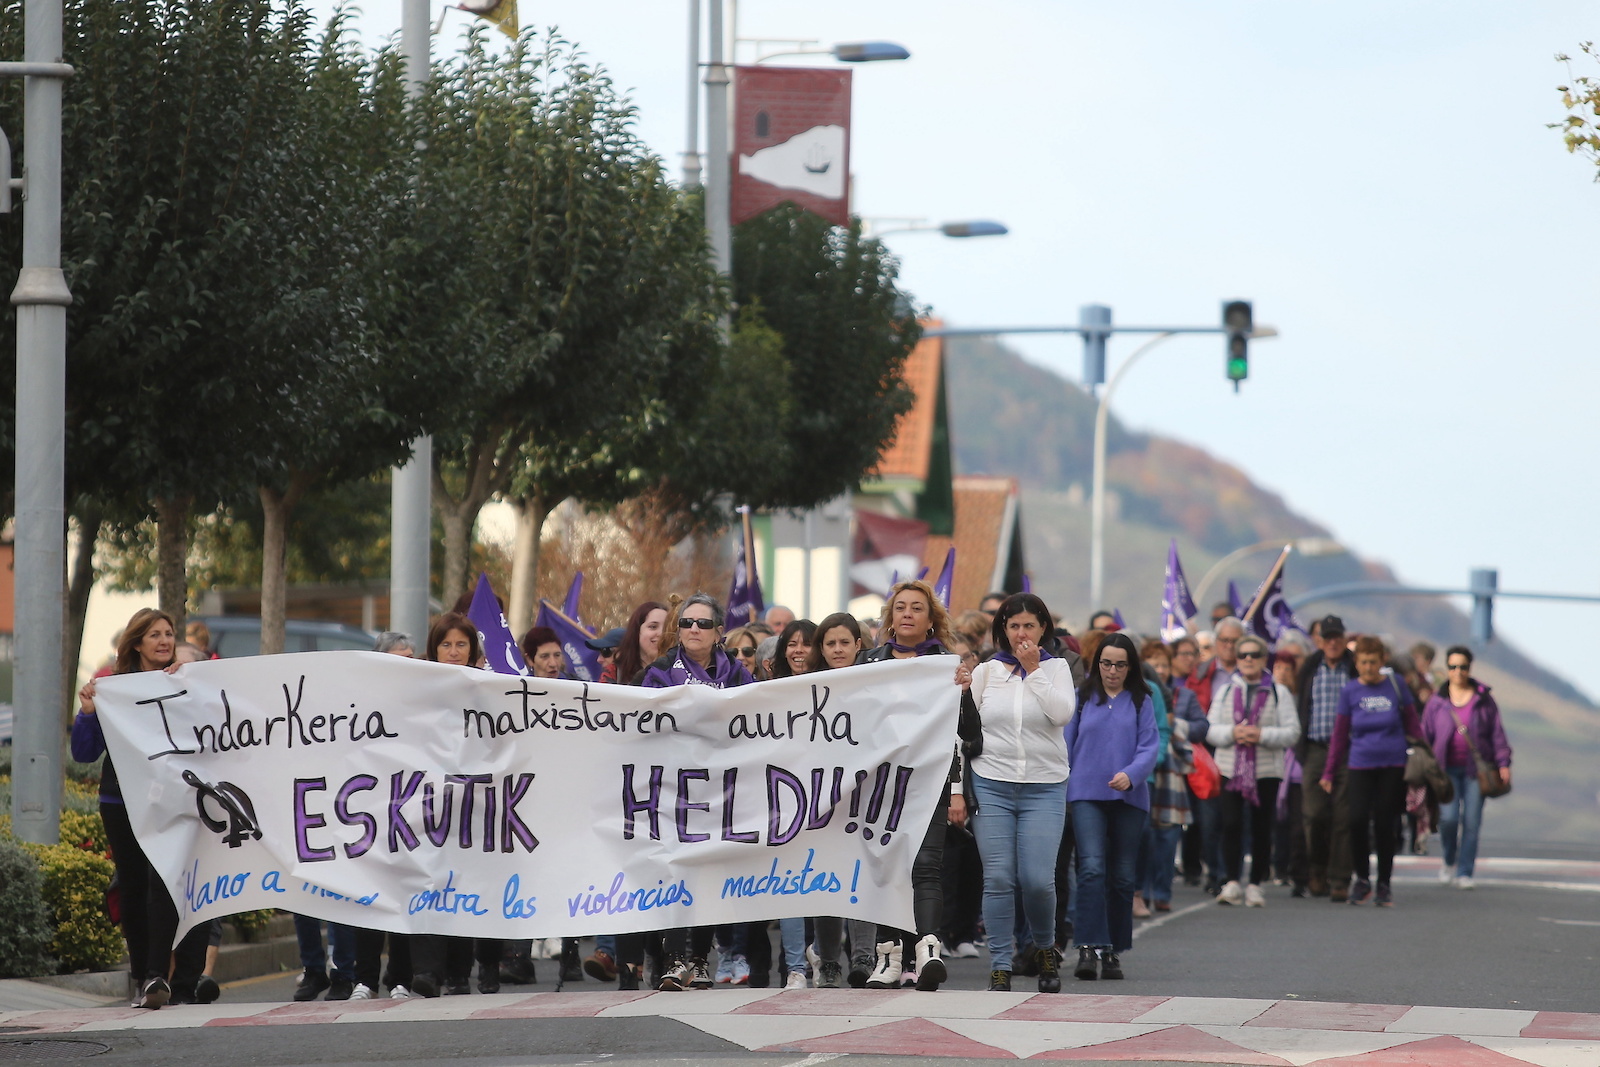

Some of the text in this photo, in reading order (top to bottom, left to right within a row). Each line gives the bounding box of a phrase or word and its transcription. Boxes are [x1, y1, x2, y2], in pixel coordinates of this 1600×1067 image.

[463, 679, 679, 738] matxistaren
[293, 761, 914, 863] ESKUTIK HELDU!!!
[261, 870, 286, 893] a
[408, 870, 489, 916] contra
[502, 873, 537, 919] las
[568, 871, 694, 918] violencias
